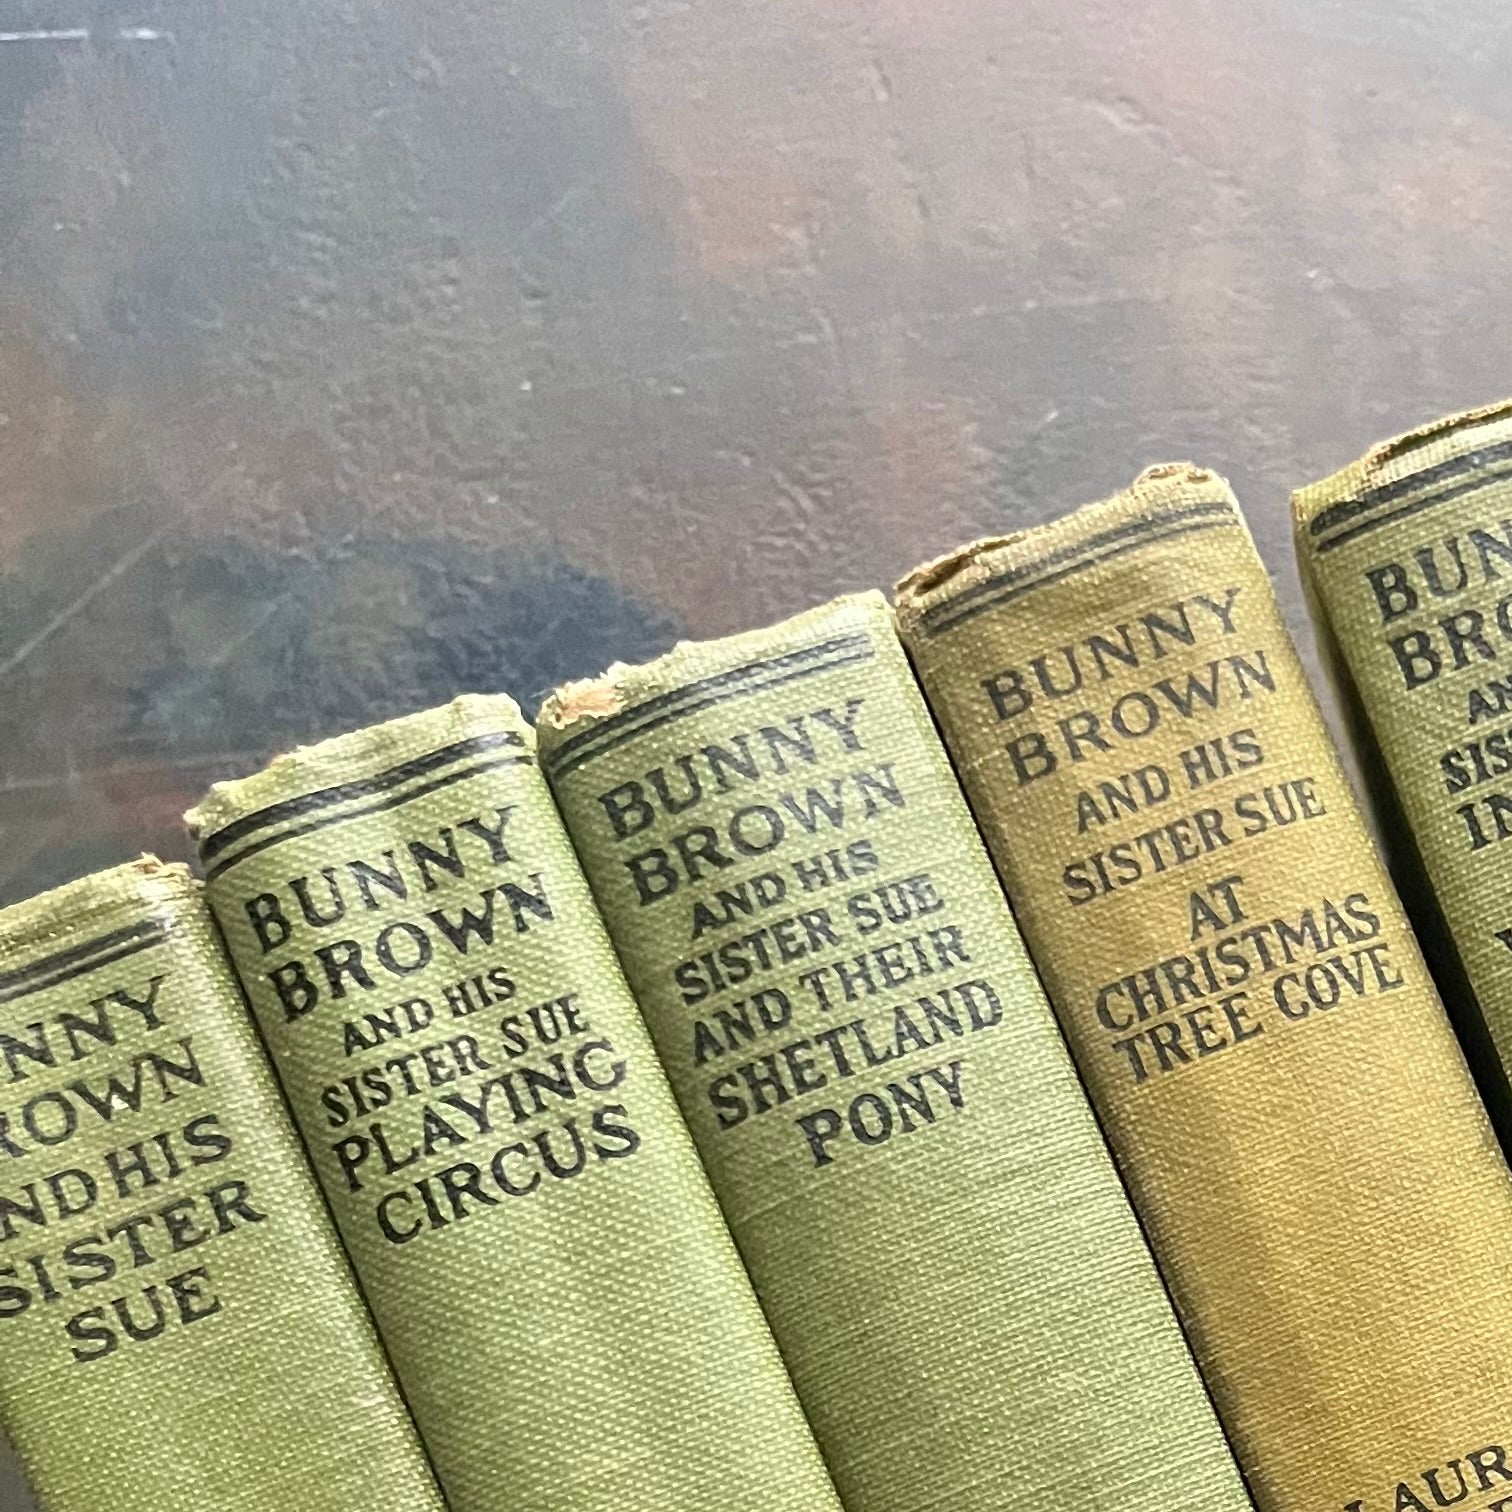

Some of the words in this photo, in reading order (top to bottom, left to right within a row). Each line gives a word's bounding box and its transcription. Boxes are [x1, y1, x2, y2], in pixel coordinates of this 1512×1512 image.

[981, 587, 1240, 721] BUNNY
[1005, 649, 1276, 787] BROWN
[599, 698, 866, 842] BUNNY
[624, 763, 906, 905] BROWN
[1077, 764, 1171, 834] AND
[1177, 728, 1265, 789] HIS
[244, 805, 518, 953] BUNNY
[691, 872, 785, 940] AND
[791, 839, 879, 892] HIS
[1063, 807, 1237, 906] SISTER
[1237, 777, 1327, 838] SUE
[1190, 875, 1249, 942] AT
[268, 873, 554, 1024] BROWN
[674, 912, 839, 1006] SISTER
[854, 875, 943, 934] SUE
[694, 988, 792, 1068] AND
[801, 923, 970, 1013] THEIR
[1097, 893, 1380, 1033] CHRISTMAS
[321, 1035, 491, 1127] SISTER
[500, 994, 589, 1059] SUE
[341, 998, 434, 1057] AND
[442, 967, 516, 1018] HIS
[706, 979, 1003, 1131] SHETLAND
[1112, 993, 1263, 1084] TREE
[1274, 943, 1404, 1021] COVE
[105, 1114, 234, 1198] HIS
[332, 1039, 627, 1192] PLAYING
[376, 1104, 641, 1245] CIRCUS
[795, 1060, 965, 1168] PONY
[65, 1266, 224, 1362] SUE
